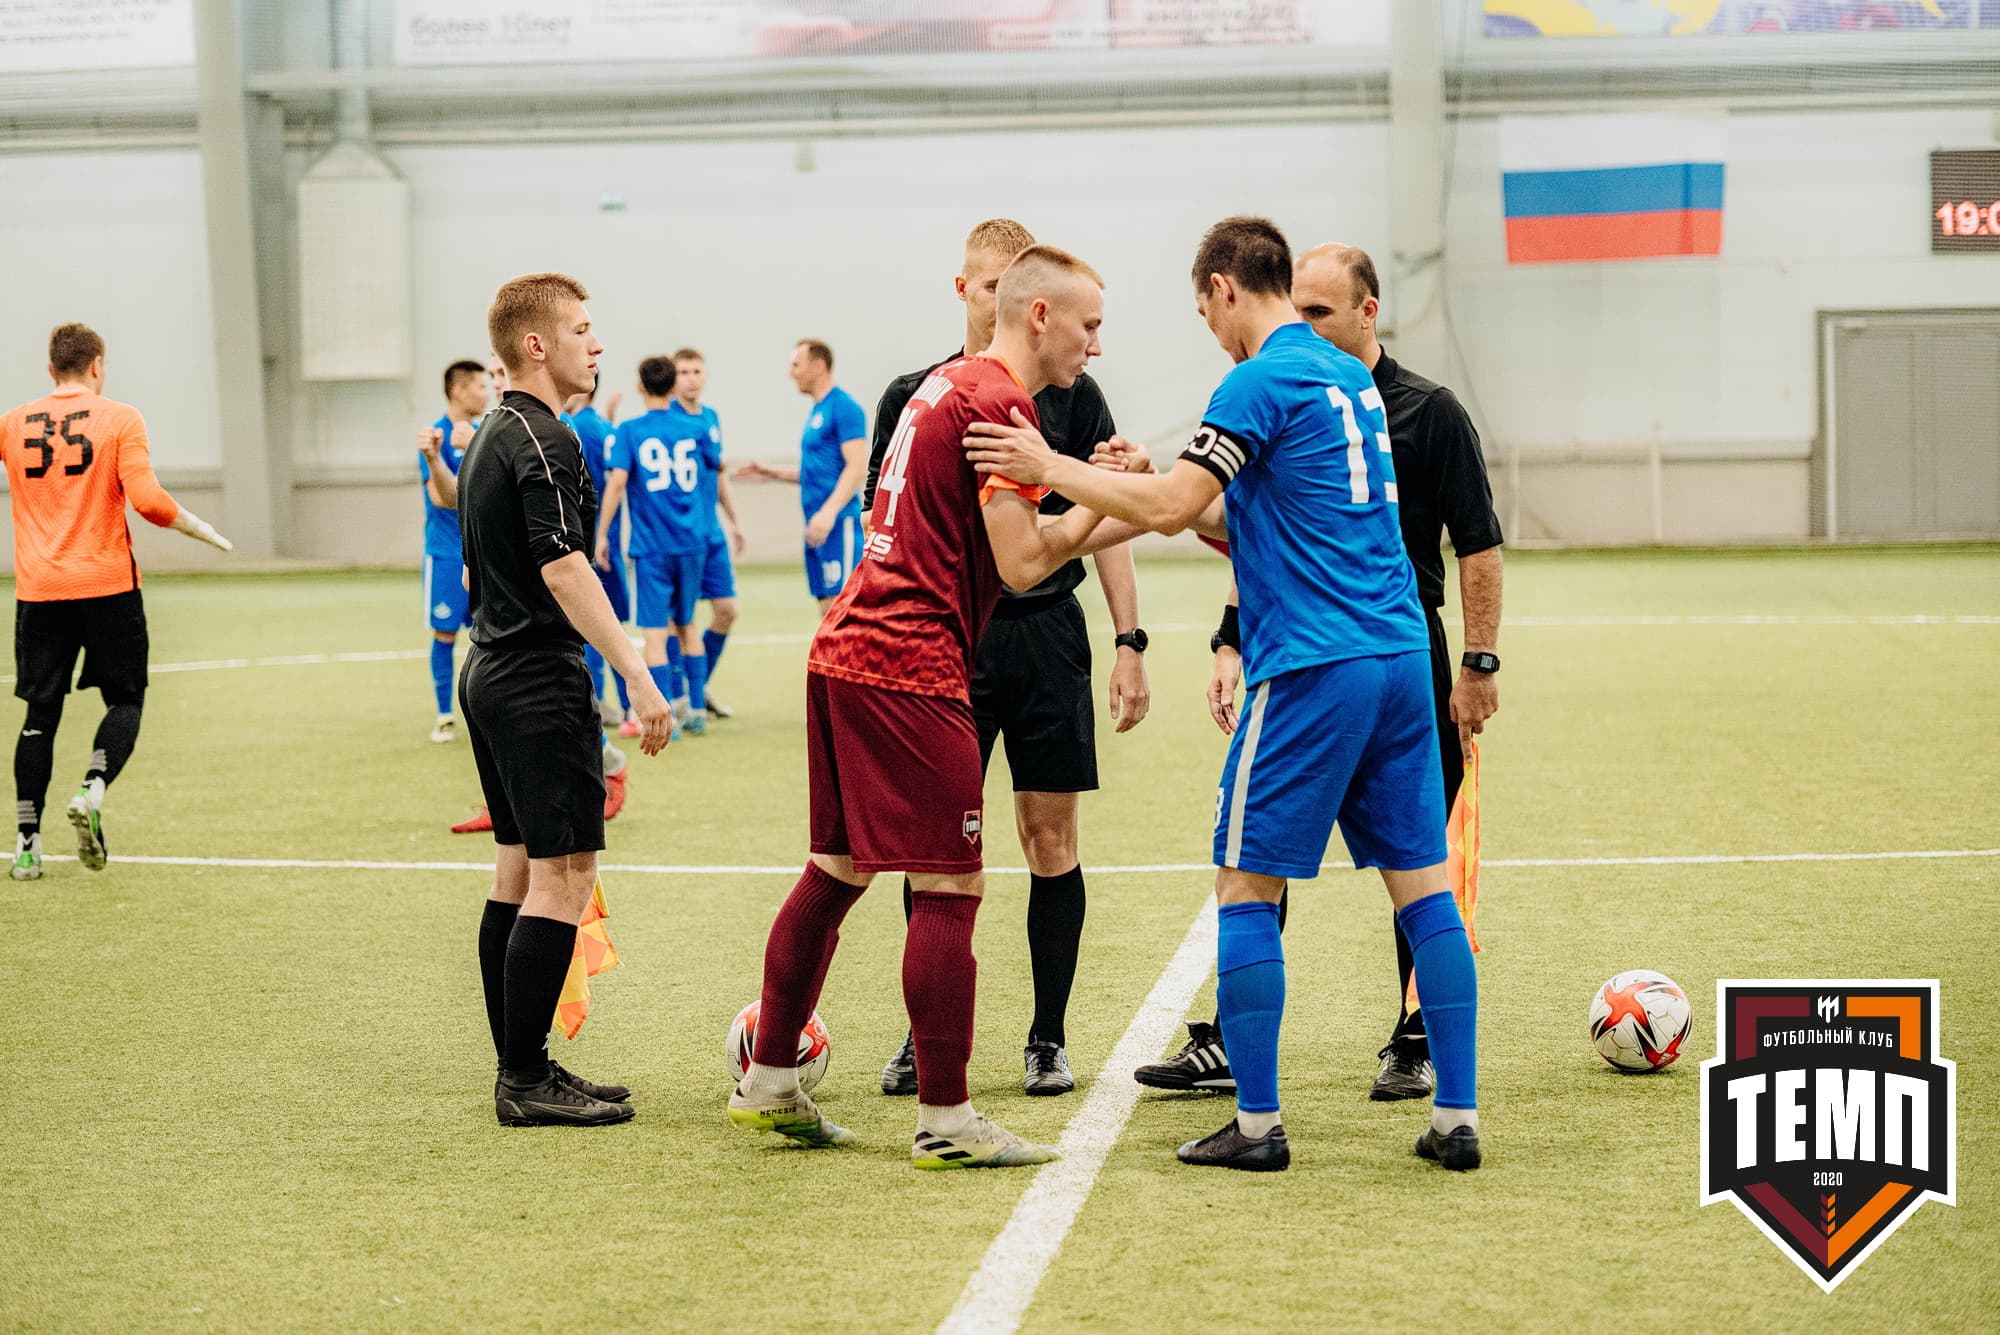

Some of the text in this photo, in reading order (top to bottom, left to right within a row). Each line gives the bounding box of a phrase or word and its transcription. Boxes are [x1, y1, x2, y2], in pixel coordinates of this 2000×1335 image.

[24, 410, 93, 478] 35
[638, 437, 698, 493] 96
[760, 1105, 797, 1117] NEMESIS
